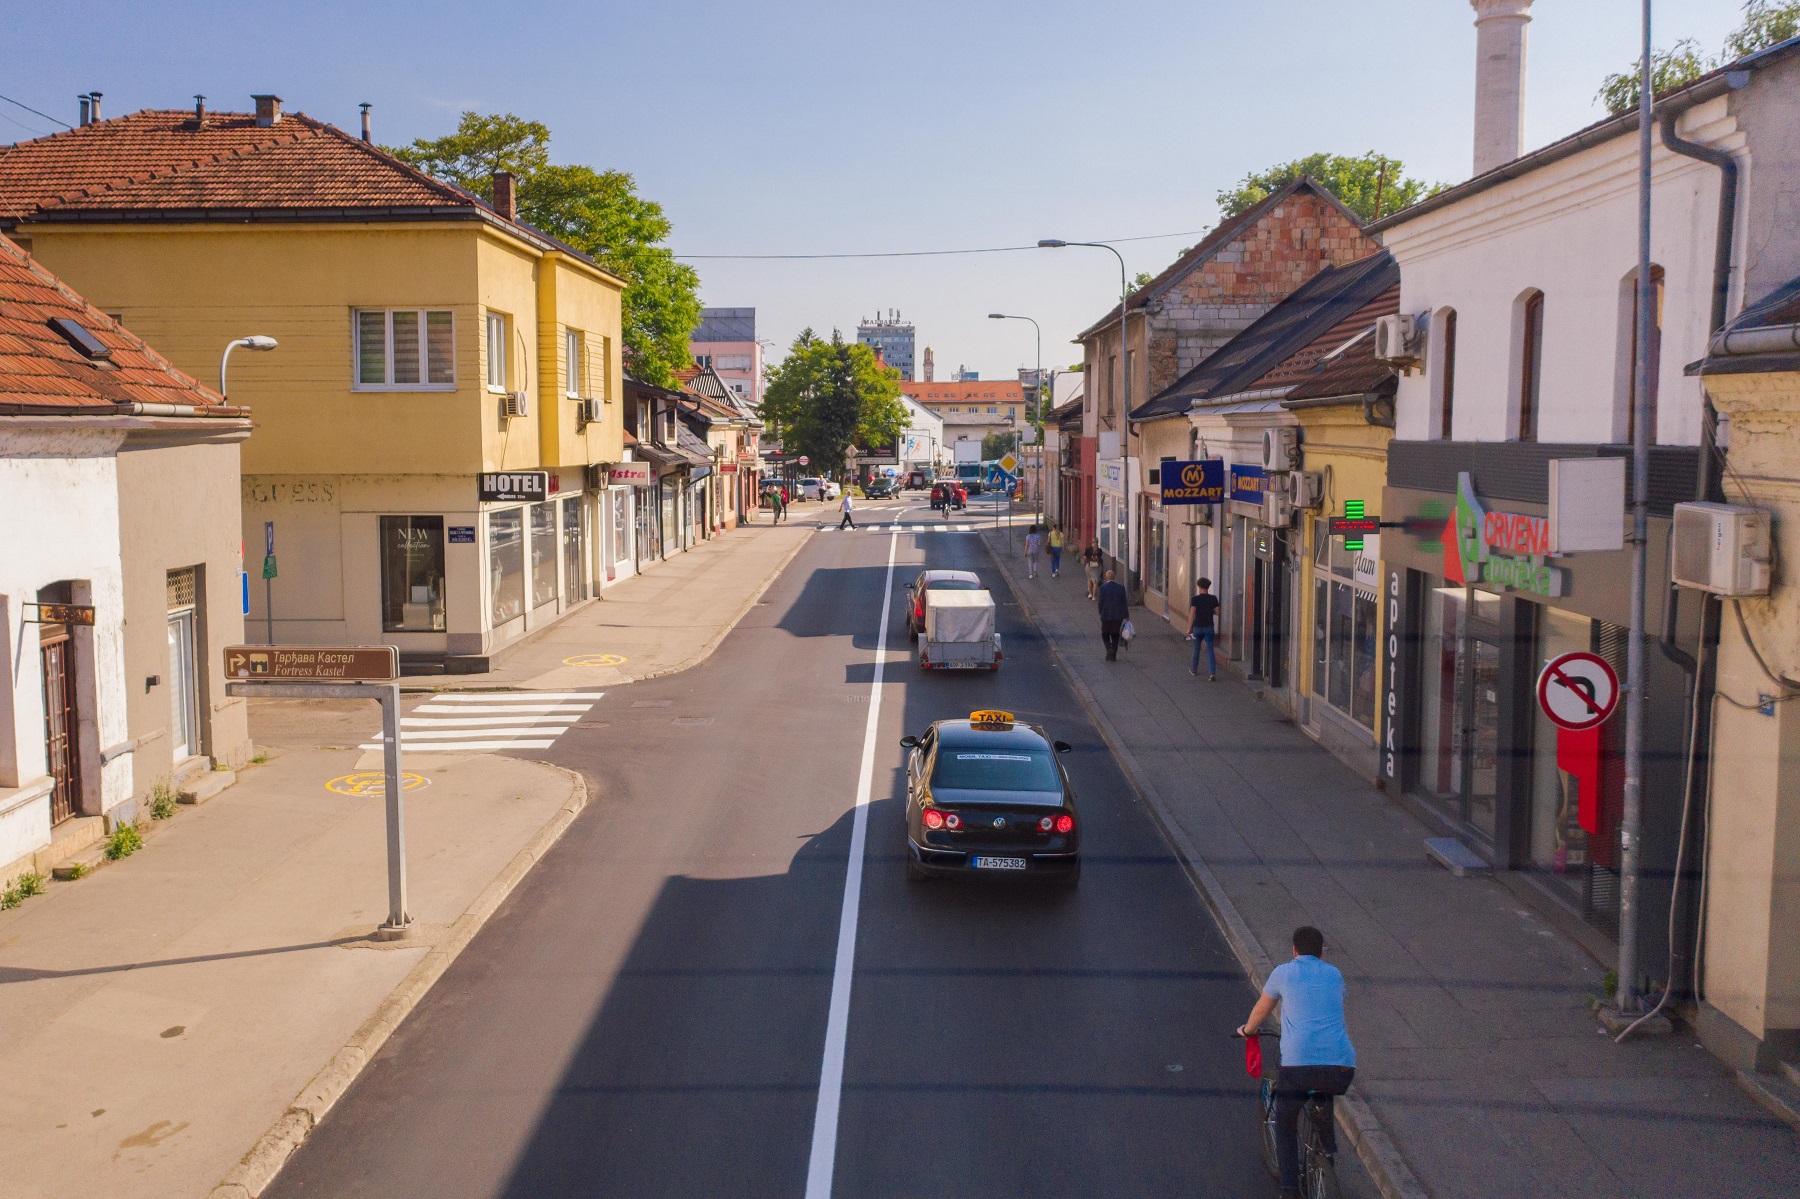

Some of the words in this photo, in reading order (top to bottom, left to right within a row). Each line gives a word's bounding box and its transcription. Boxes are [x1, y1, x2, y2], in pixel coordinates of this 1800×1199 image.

[484, 475, 542, 492] HOTEL
[1238, 476, 1259, 492] MOZZART
[1164, 487, 1222, 498] MOZZART
[267, 526, 272, 551] P
[398, 528, 428, 540] NEW
[1484, 511, 1552, 557] CRVENA
[396, 540, 430, 551] collection
[1484, 554, 1551, 596] apoteka
[274, 651, 314, 665] Тврђава
[318, 652, 354, 663] Кастел
[274, 665, 312, 676] Fortress
[316, 665, 345, 676] Kastel
[1386, 572, 1399, 778] apoteka
[978, 858, 1025, 868] TA-575382
